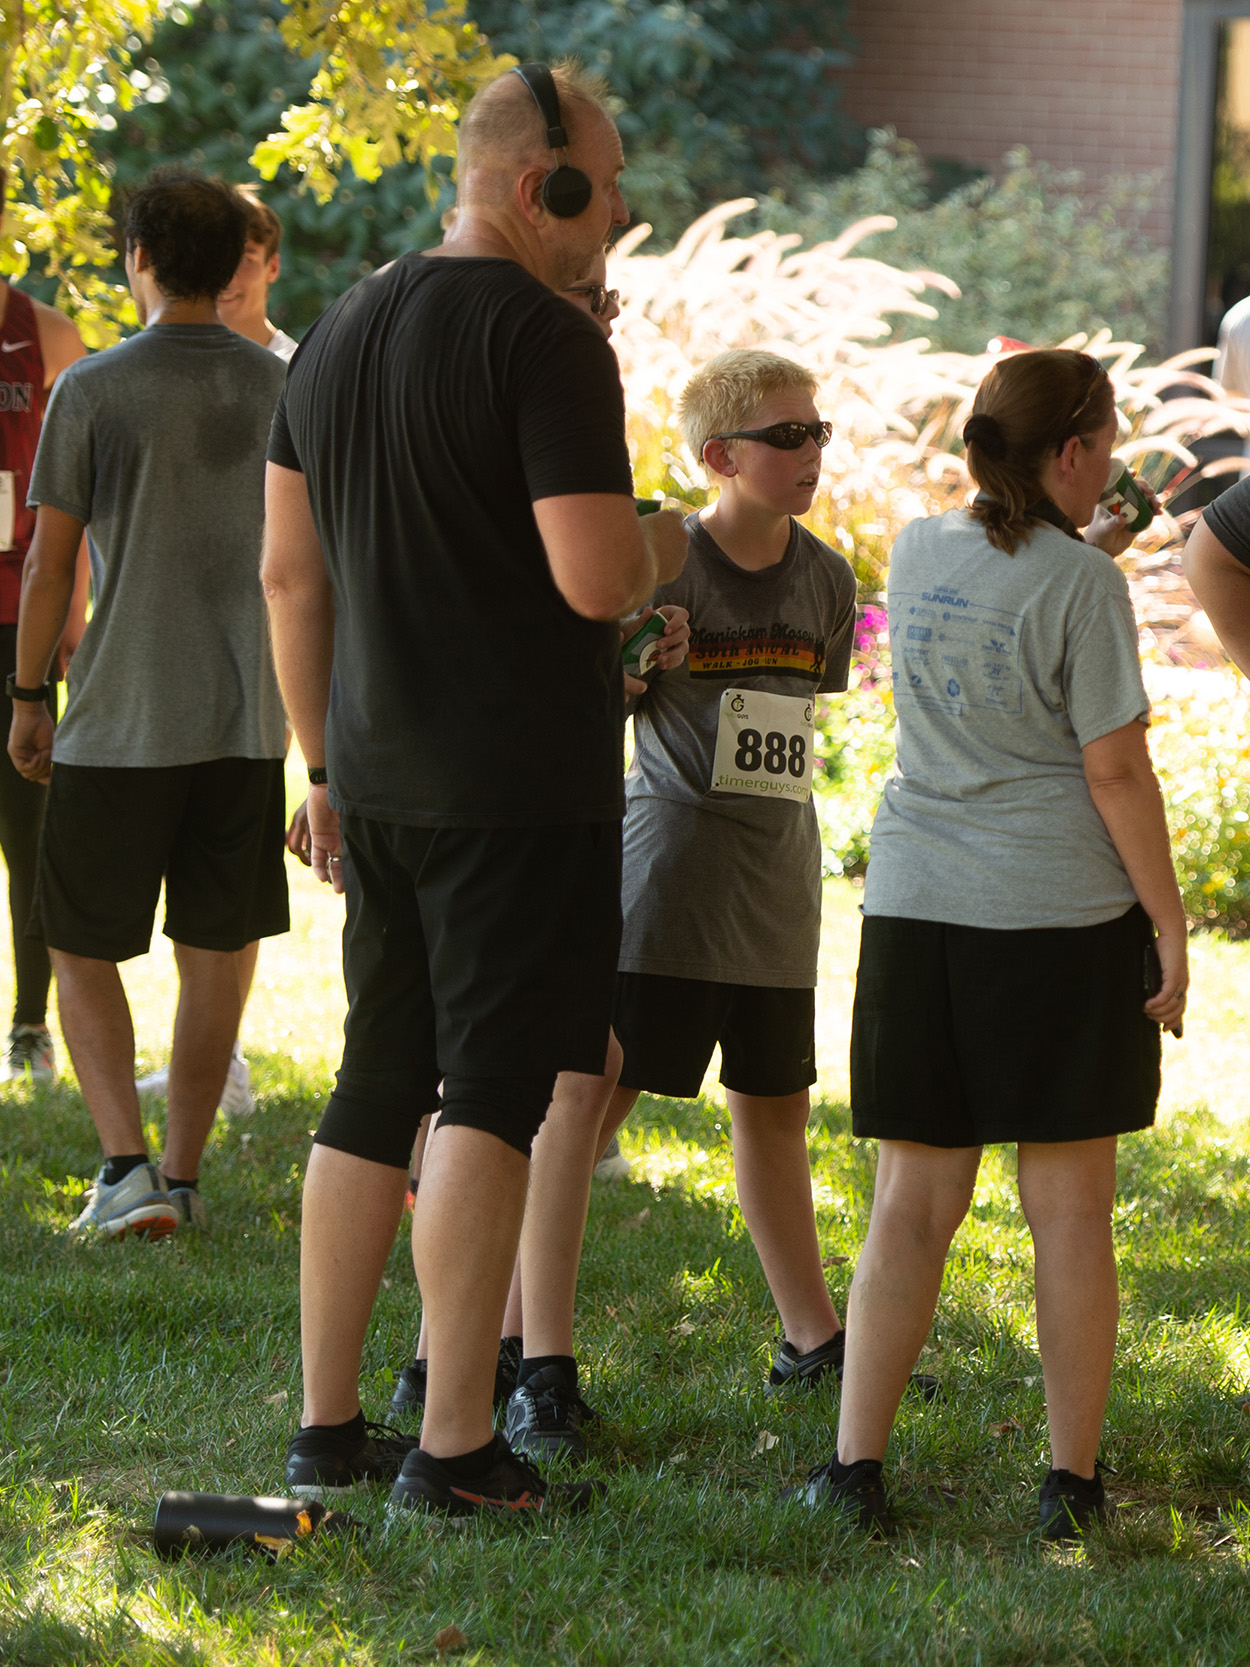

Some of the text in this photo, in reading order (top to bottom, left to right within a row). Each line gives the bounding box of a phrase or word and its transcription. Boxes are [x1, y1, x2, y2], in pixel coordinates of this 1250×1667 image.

[921, 591, 969, 608] SUNRUN
[702, 661, 733, 669] WALK
[742, 658, 759, 666] JOG
[735, 728, 806, 778] 888
[719, 775, 808, 794] timerguys.com
